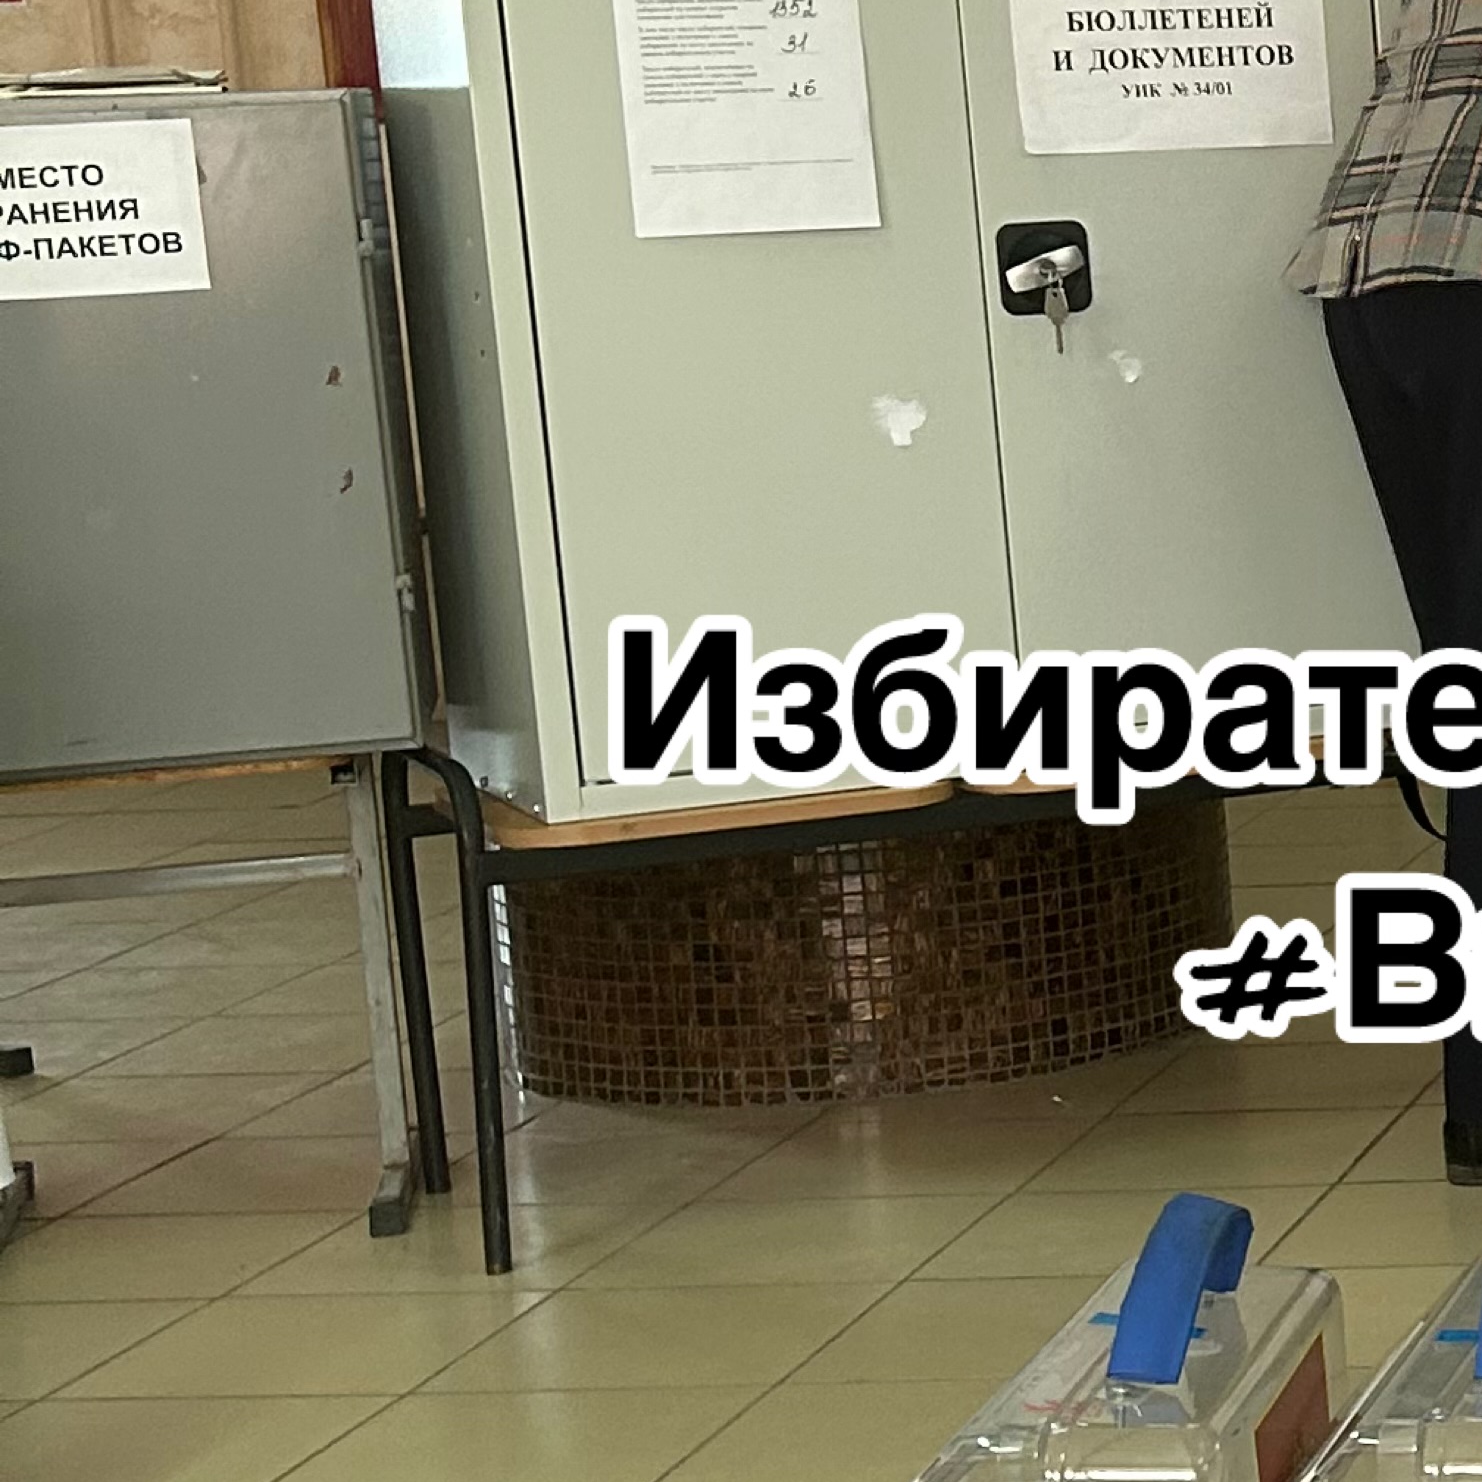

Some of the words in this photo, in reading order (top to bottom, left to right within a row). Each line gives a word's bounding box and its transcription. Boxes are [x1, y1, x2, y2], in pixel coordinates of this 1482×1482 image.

[1066, 1, 1275, 32] БЮЛЛЕТЕНЕЙ
[1053, 49, 1073, 71] И
[1088, 44, 1295, 74] ДОКУМЕНТОВ
[1121, 83, 1162, 99] УИК
[1193, 81, 1233, 97] 34/01
[0, 198, 139, 226] АНЕНИЯ
